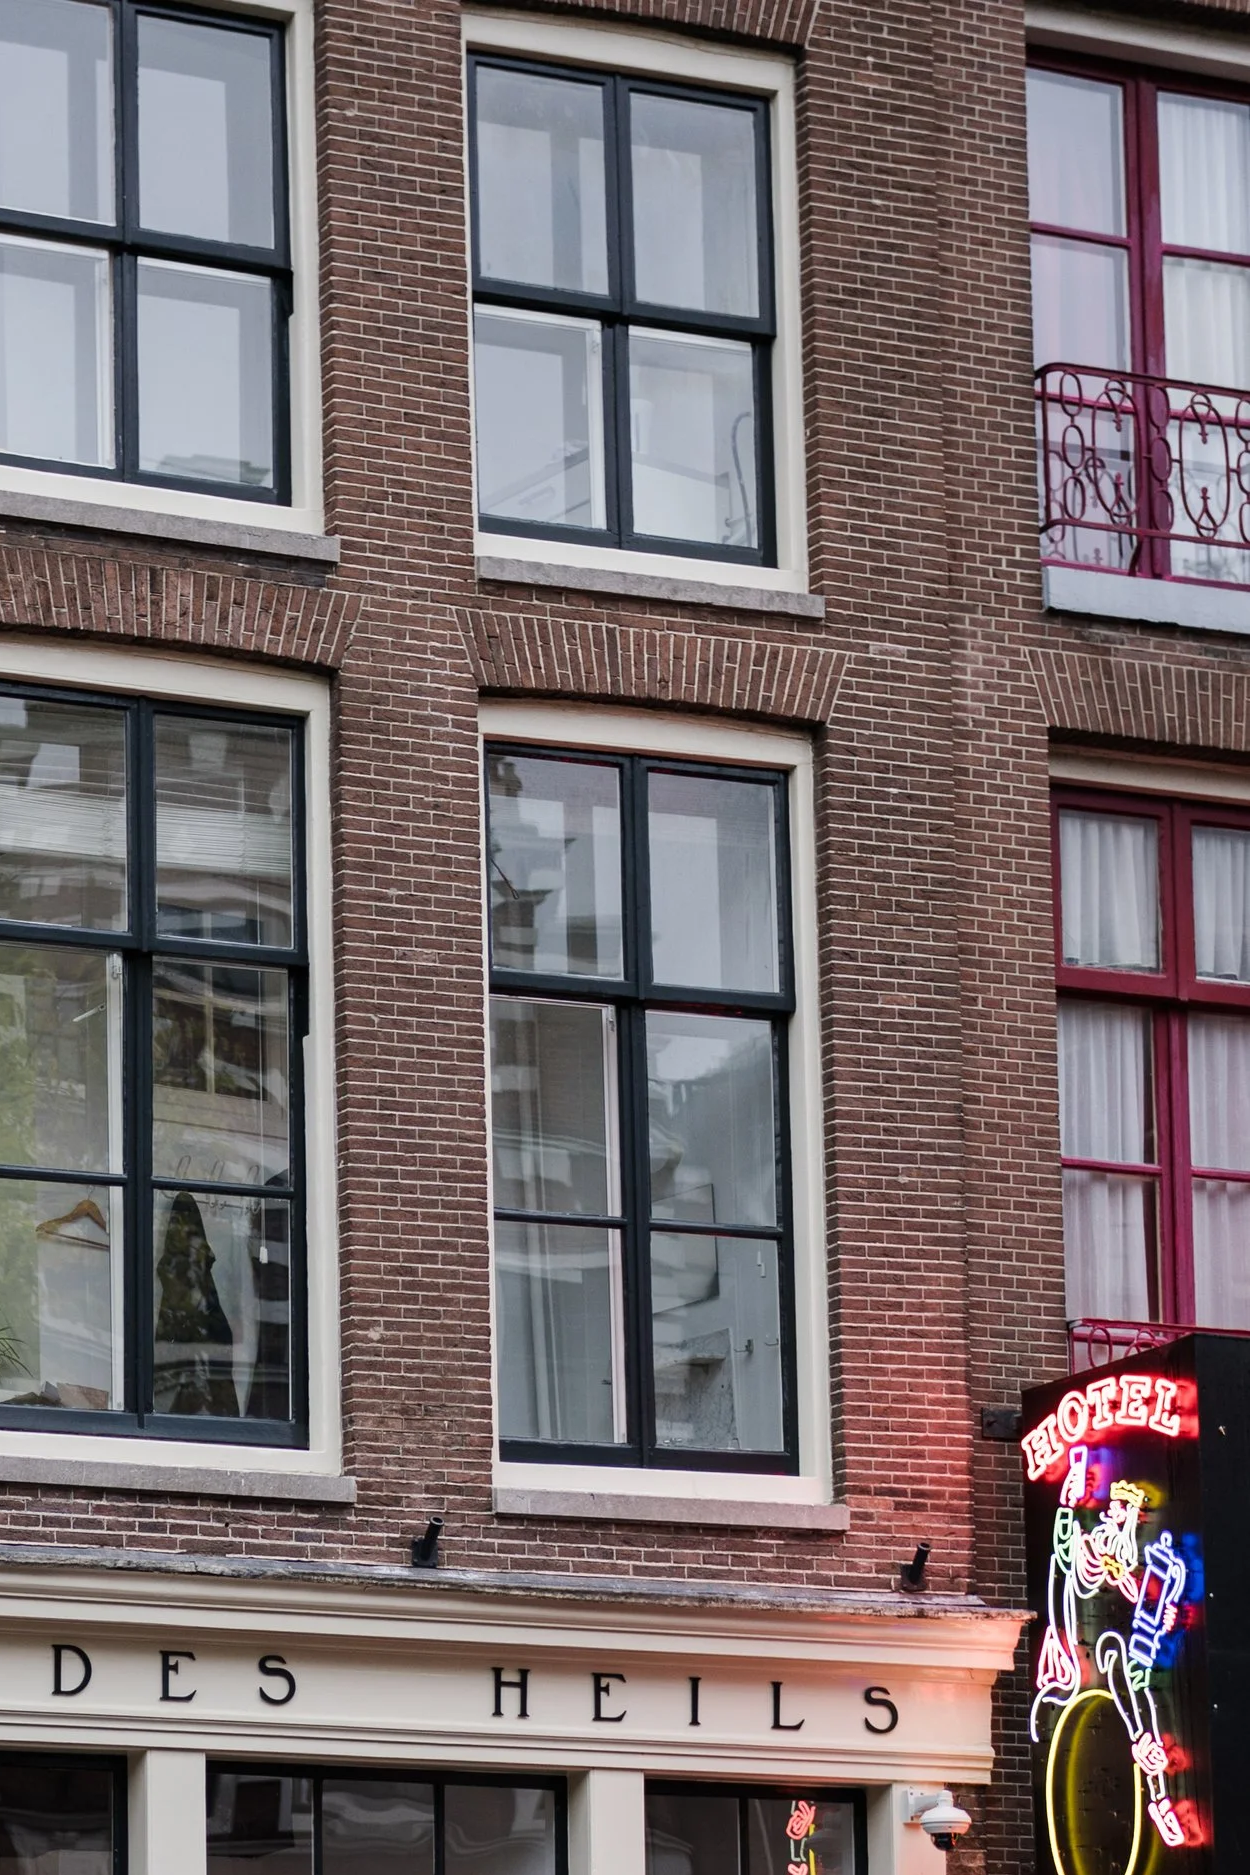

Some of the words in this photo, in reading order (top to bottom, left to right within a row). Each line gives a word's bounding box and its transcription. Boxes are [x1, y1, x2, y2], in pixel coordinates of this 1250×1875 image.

[1021, 1374, 1181, 1481] HOTEL
[51, 1644, 297, 1706] DES
[490, 1666, 900, 1735] HEILS
